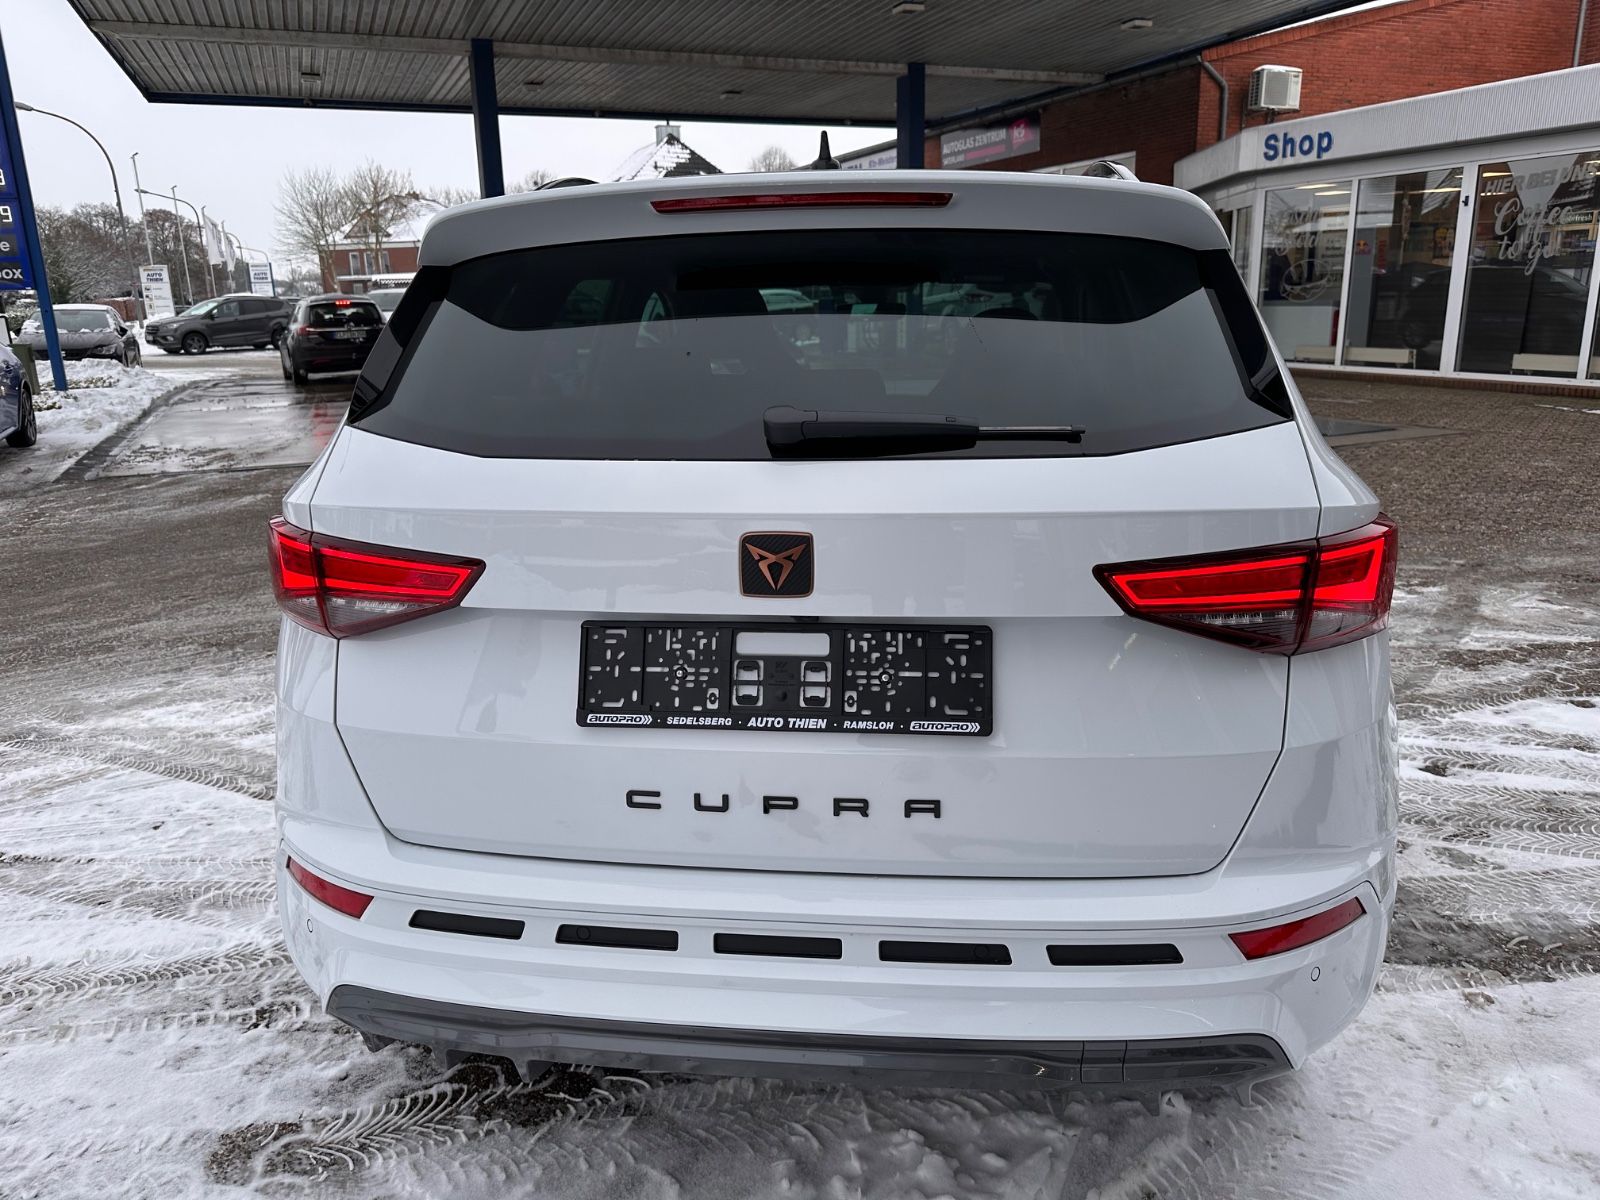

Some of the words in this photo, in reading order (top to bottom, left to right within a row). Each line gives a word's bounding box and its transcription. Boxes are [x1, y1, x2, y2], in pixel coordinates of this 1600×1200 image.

[943, 136, 974, 154] AUTOGLAS
[975, 128, 1006, 147] ZENTRUM
[1264, 131, 1333, 161] Shop
[1485, 176, 1524, 193] HIER
[0, 268, 23, 279] ox
[666, 716, 732, 726] SEDELSBERG
[747, 718, 784, 729] AUTO
[788, 718, 827, 729] THIEN
[843, 721, 894, 730] RAMSLOH
[626, 790, 941, 819] CUPRA
